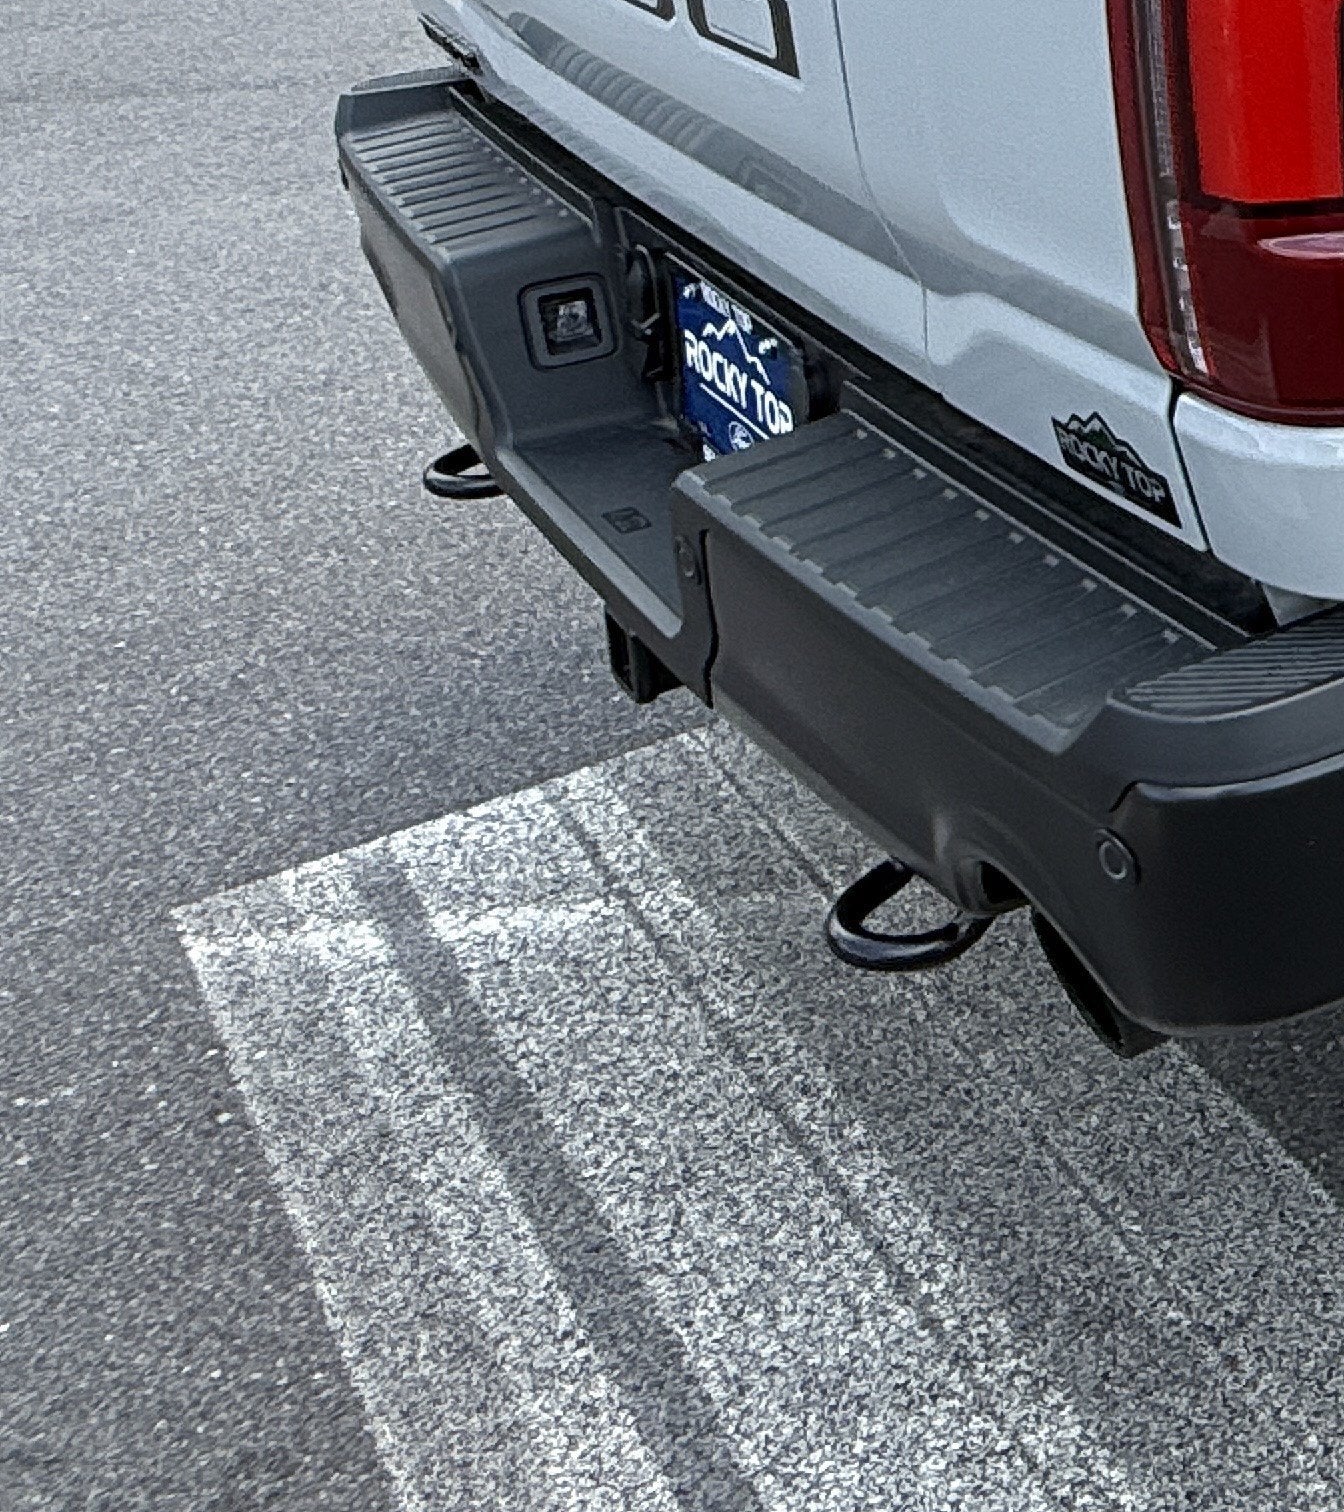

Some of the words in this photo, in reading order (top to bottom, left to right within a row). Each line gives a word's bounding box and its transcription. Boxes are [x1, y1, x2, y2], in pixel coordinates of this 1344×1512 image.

[684, 329, 748, 410] ROCKY
[750, 378, 795, 435] TOP
[1056, 426, 1120, 481] ROCKY
[1120, 461, 1167, 503] TOP
